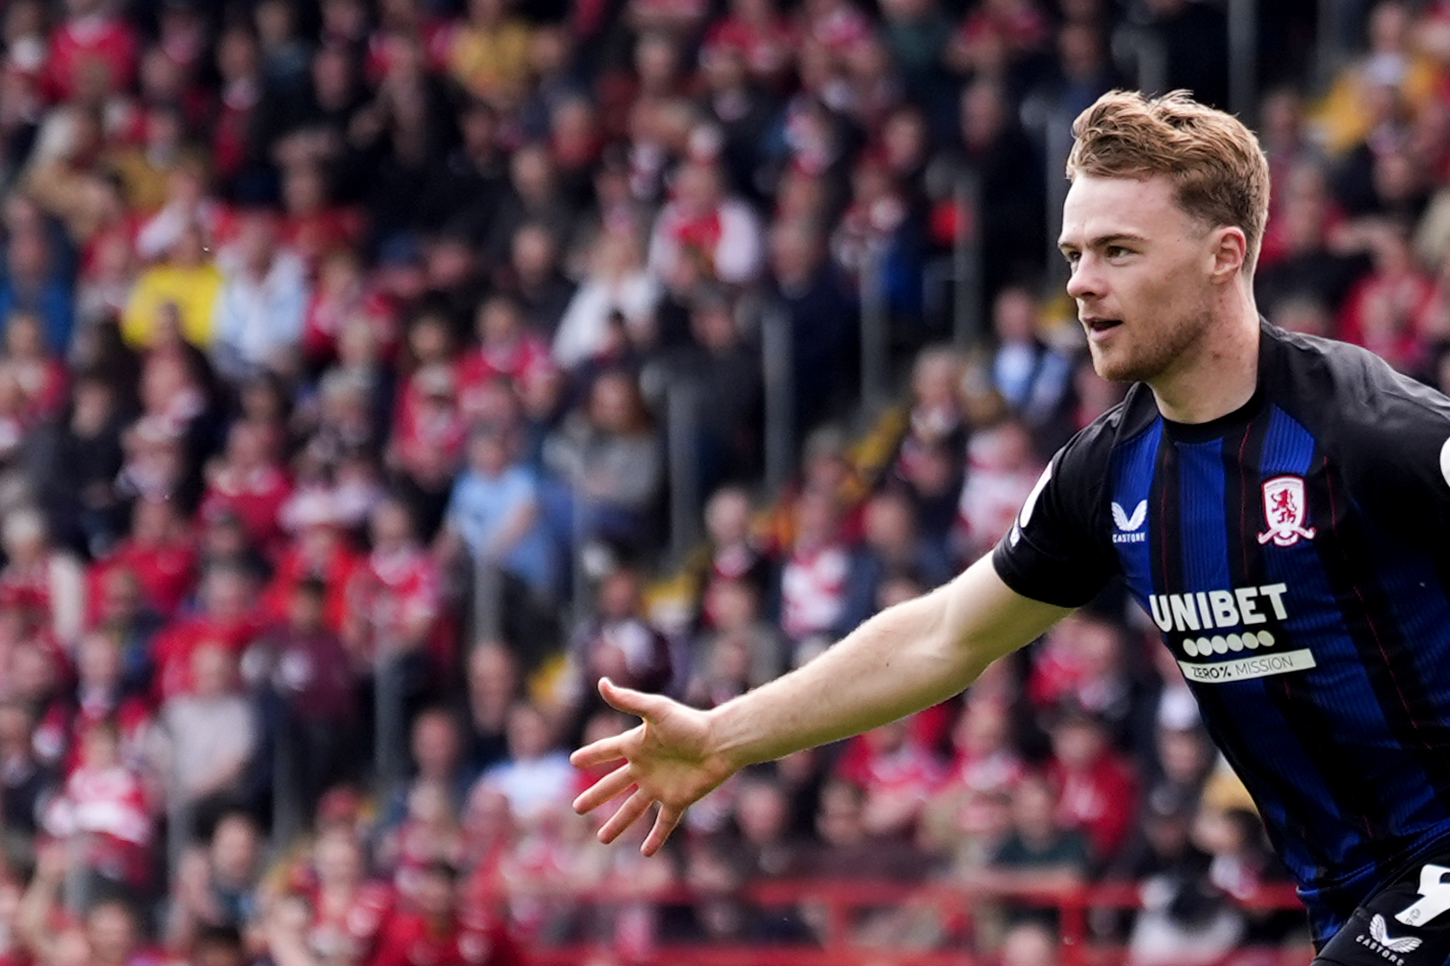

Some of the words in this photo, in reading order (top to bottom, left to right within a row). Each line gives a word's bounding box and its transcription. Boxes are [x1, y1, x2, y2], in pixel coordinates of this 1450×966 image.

[1149, 583, 1288, 632] UNIBET
[1191, 665, 1232, 680] ZERO%
[1235, 656, 1294, 677] MISSION
